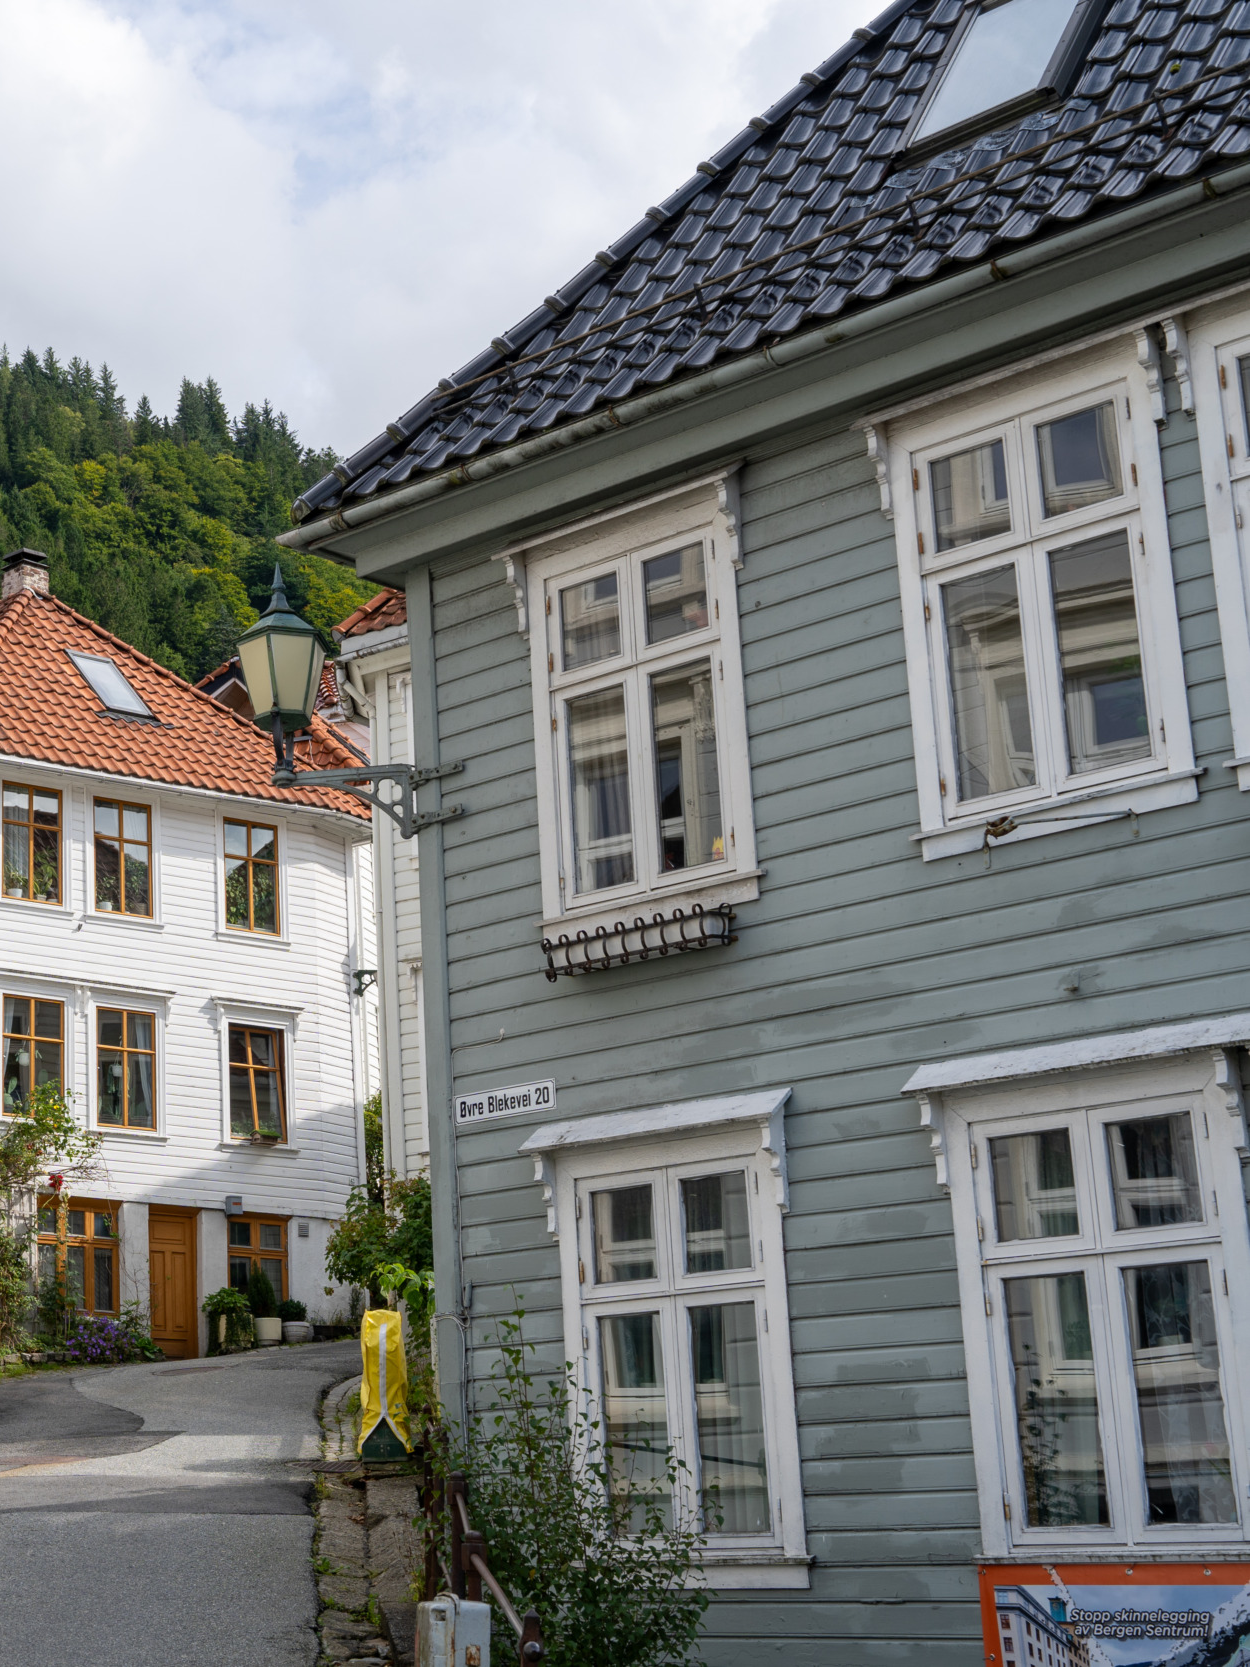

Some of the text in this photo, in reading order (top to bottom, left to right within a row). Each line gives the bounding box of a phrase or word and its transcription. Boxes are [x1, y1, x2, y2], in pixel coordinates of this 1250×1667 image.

[460, 1087, 550, 1118] Øvre Blekevei 20
[1071, 1608, 1210, 1625] Stopp skinnelegging
[1074, 1623, 1209, 1638] av Bergen Sentrum!
